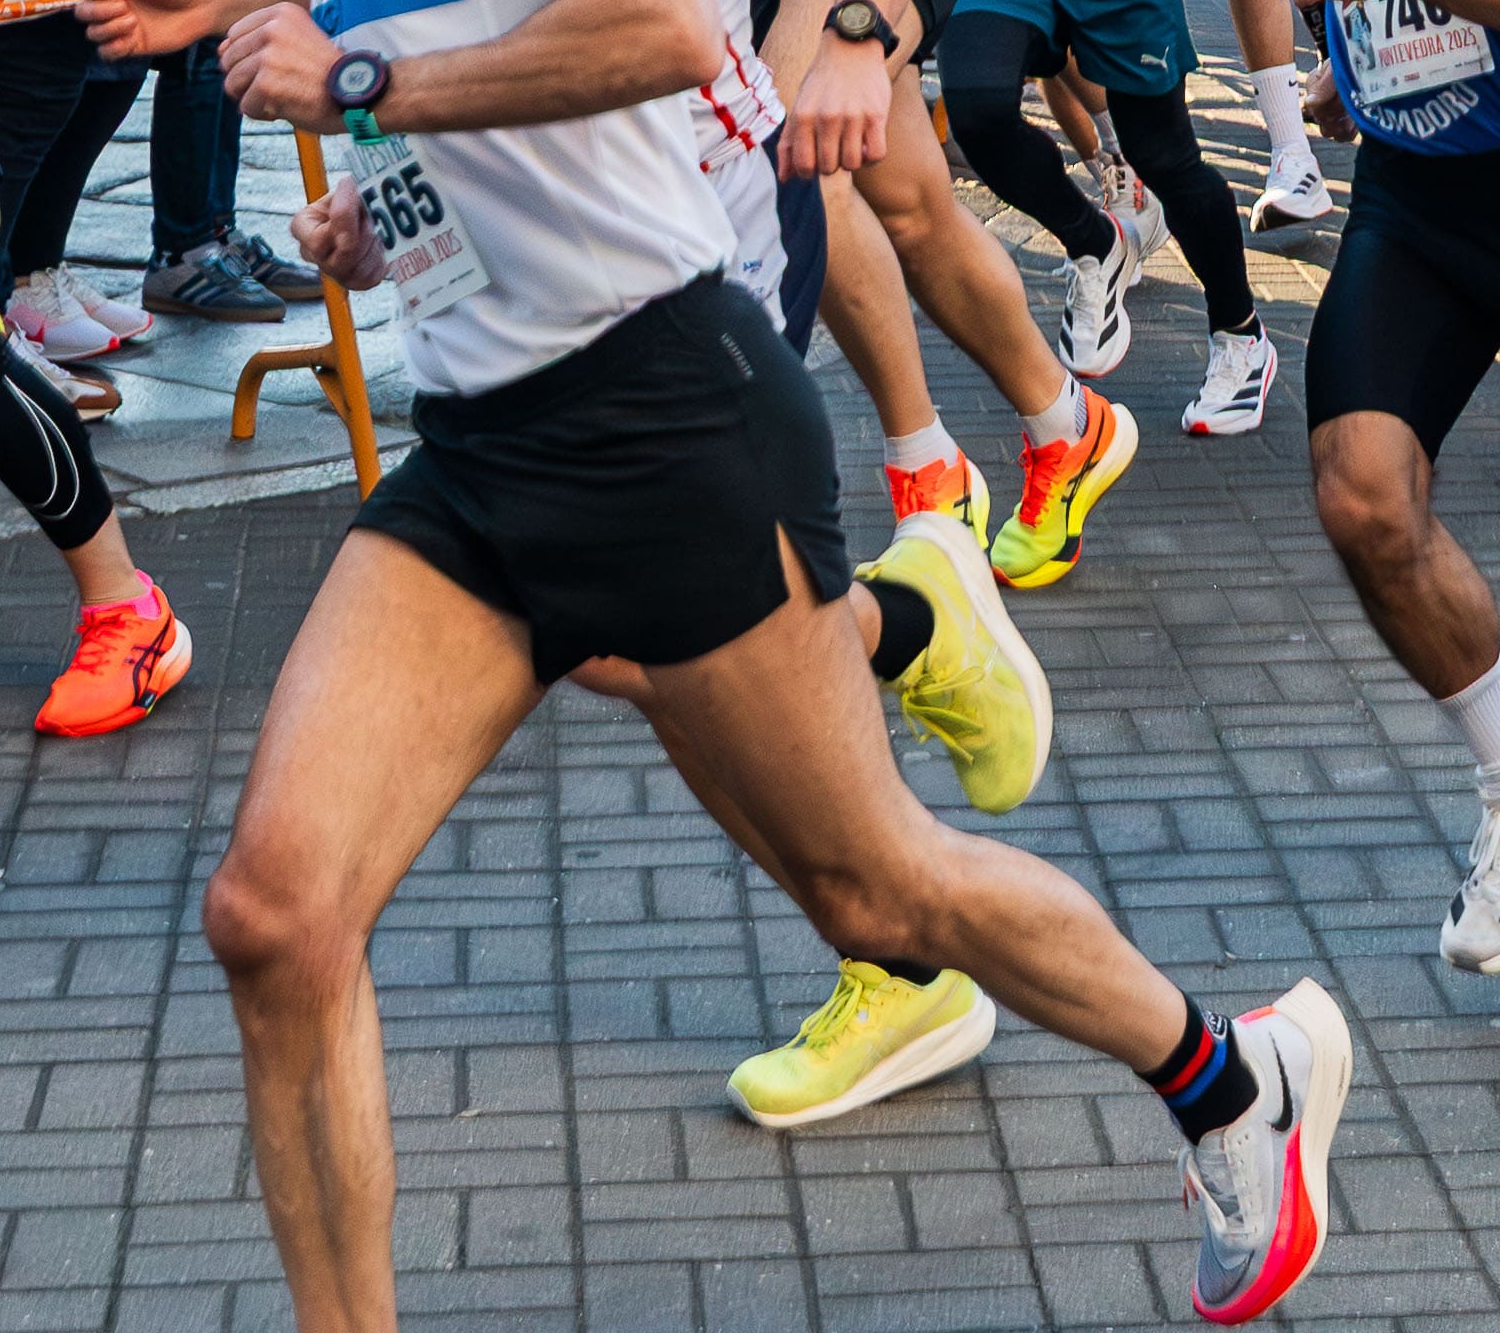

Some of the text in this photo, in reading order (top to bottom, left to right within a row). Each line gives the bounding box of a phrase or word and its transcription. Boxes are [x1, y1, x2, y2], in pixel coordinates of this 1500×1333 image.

[1377, 25, 1478, 69] PONTEVEDRA 2025
[361, 160, 445, 251] 565
[429, 229, 464, 264] 2025
